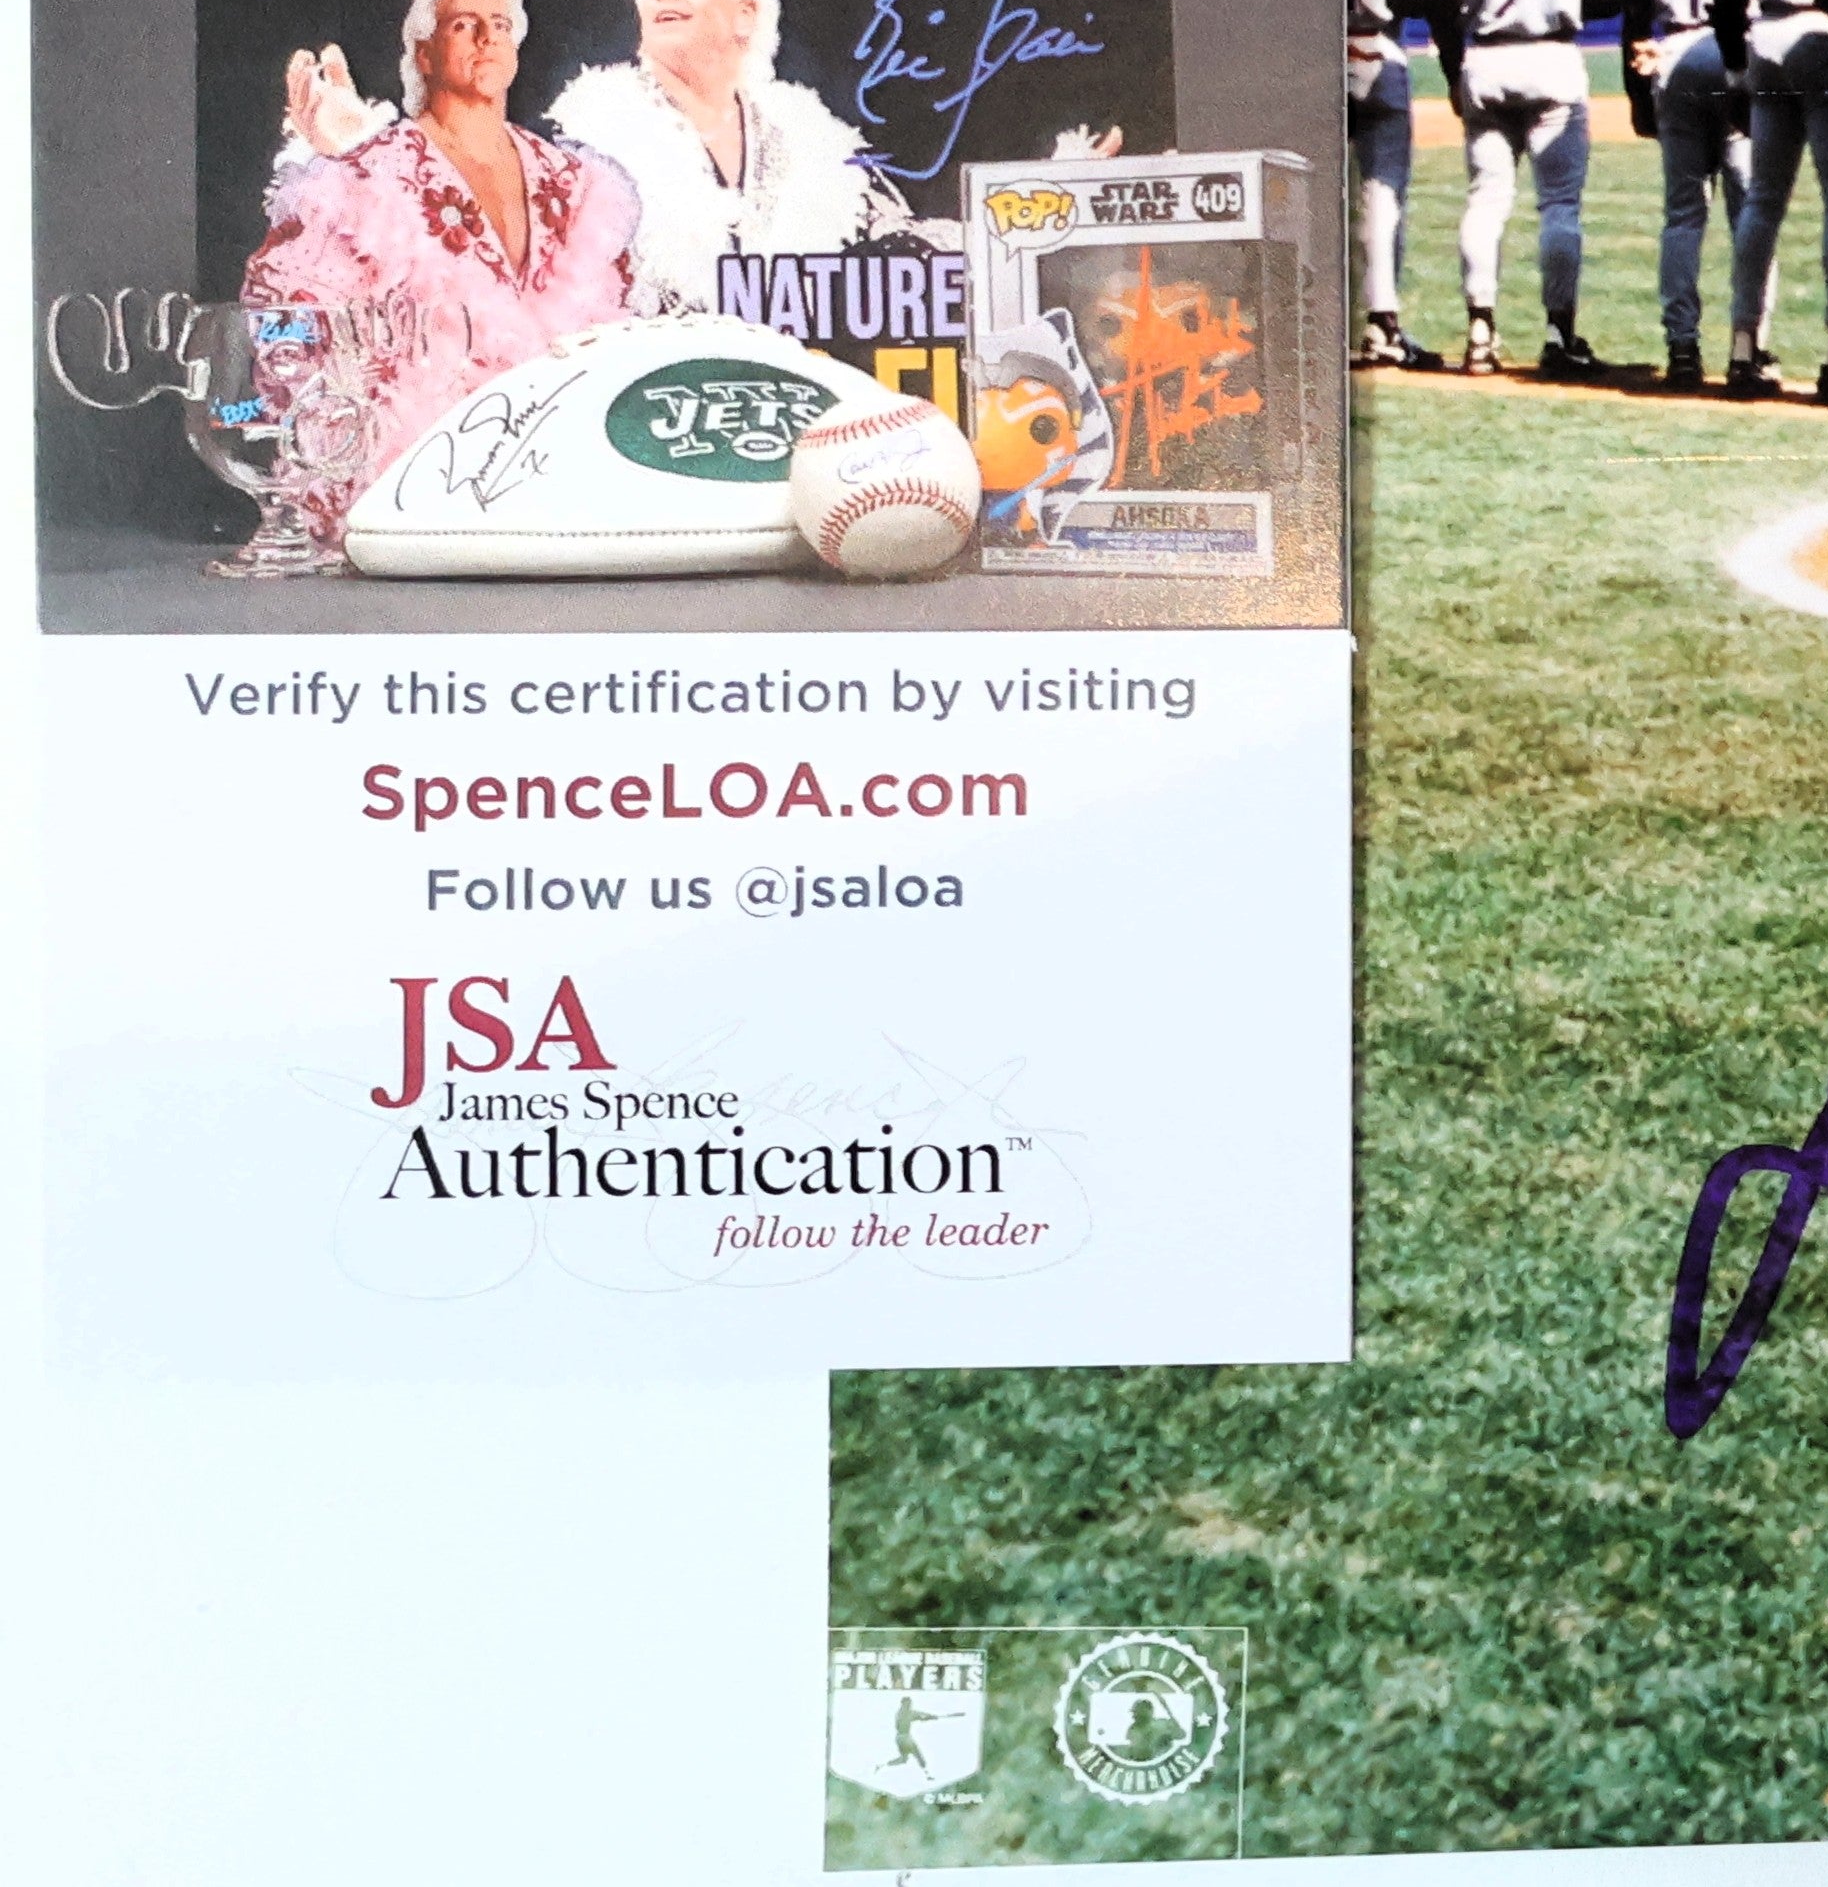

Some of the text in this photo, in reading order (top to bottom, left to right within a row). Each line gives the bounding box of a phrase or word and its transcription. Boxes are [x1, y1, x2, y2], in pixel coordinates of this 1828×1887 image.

[985, 189, 1074, 232] POP!
[1090, 182, 1178, 205] STAR
[1091, 200, 1178, 223] WARS
[1193, 185, 1241, 213] 409
[186, 668, 1194, 723] Verify this certification by visiting
[362, 762, 1026, 832] SpenceLOA.com
[429, 865, 962, 917] Follow us @jsaloa
[369, 975, 616, 1108] JSA
[439, 1081, 738, 1125] James Spence
[714, 1213, 1049, 1257] follow the leader
